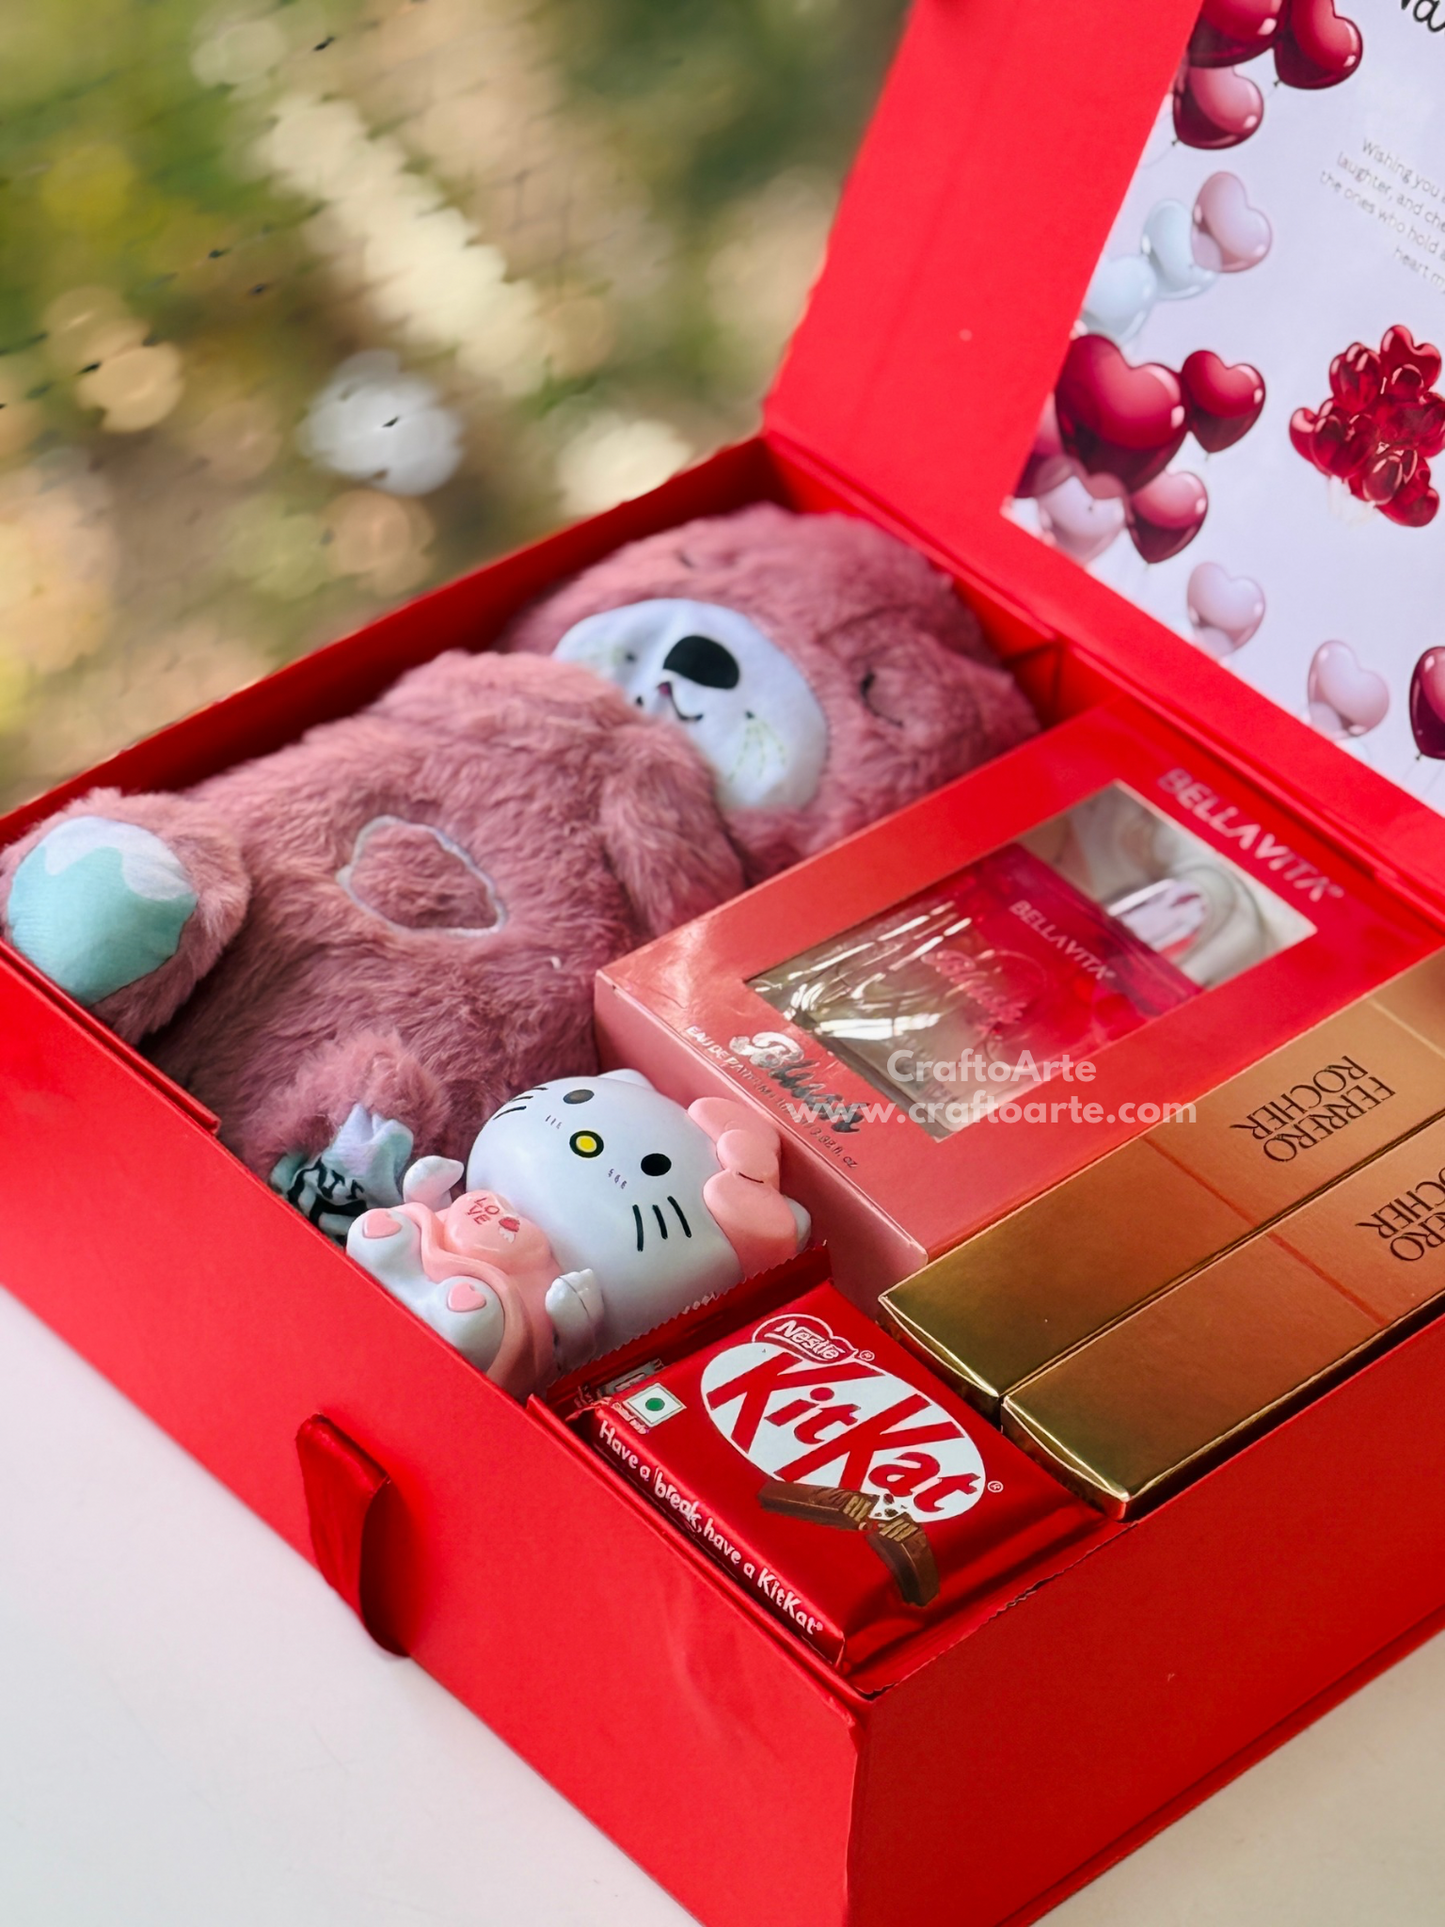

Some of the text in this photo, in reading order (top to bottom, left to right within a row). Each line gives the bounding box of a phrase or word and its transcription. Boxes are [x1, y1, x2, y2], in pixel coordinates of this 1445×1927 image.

[1337, 151, 1393, 200] laughter,
[1396, 194, 1424, 215] and
[1363, 138, 1440, 198] Wishing you
[1320, 170, 1439, 254] the ones who hold
[1394, 245, 1429, 278] heart
[1229, 1055, 1369, 1140] ROCHER
[1263, 1076, 1396, 1163] FERRERO
[467, 1205, 491, 1226] VE
[474, 1197, 500, 1215] LO
[599, 1419, 640, 1469] Have
[639, 1466, 651, 1481] a
[703, 1517, 742, 1565] have
[743, 1561, 756, 1579] a
